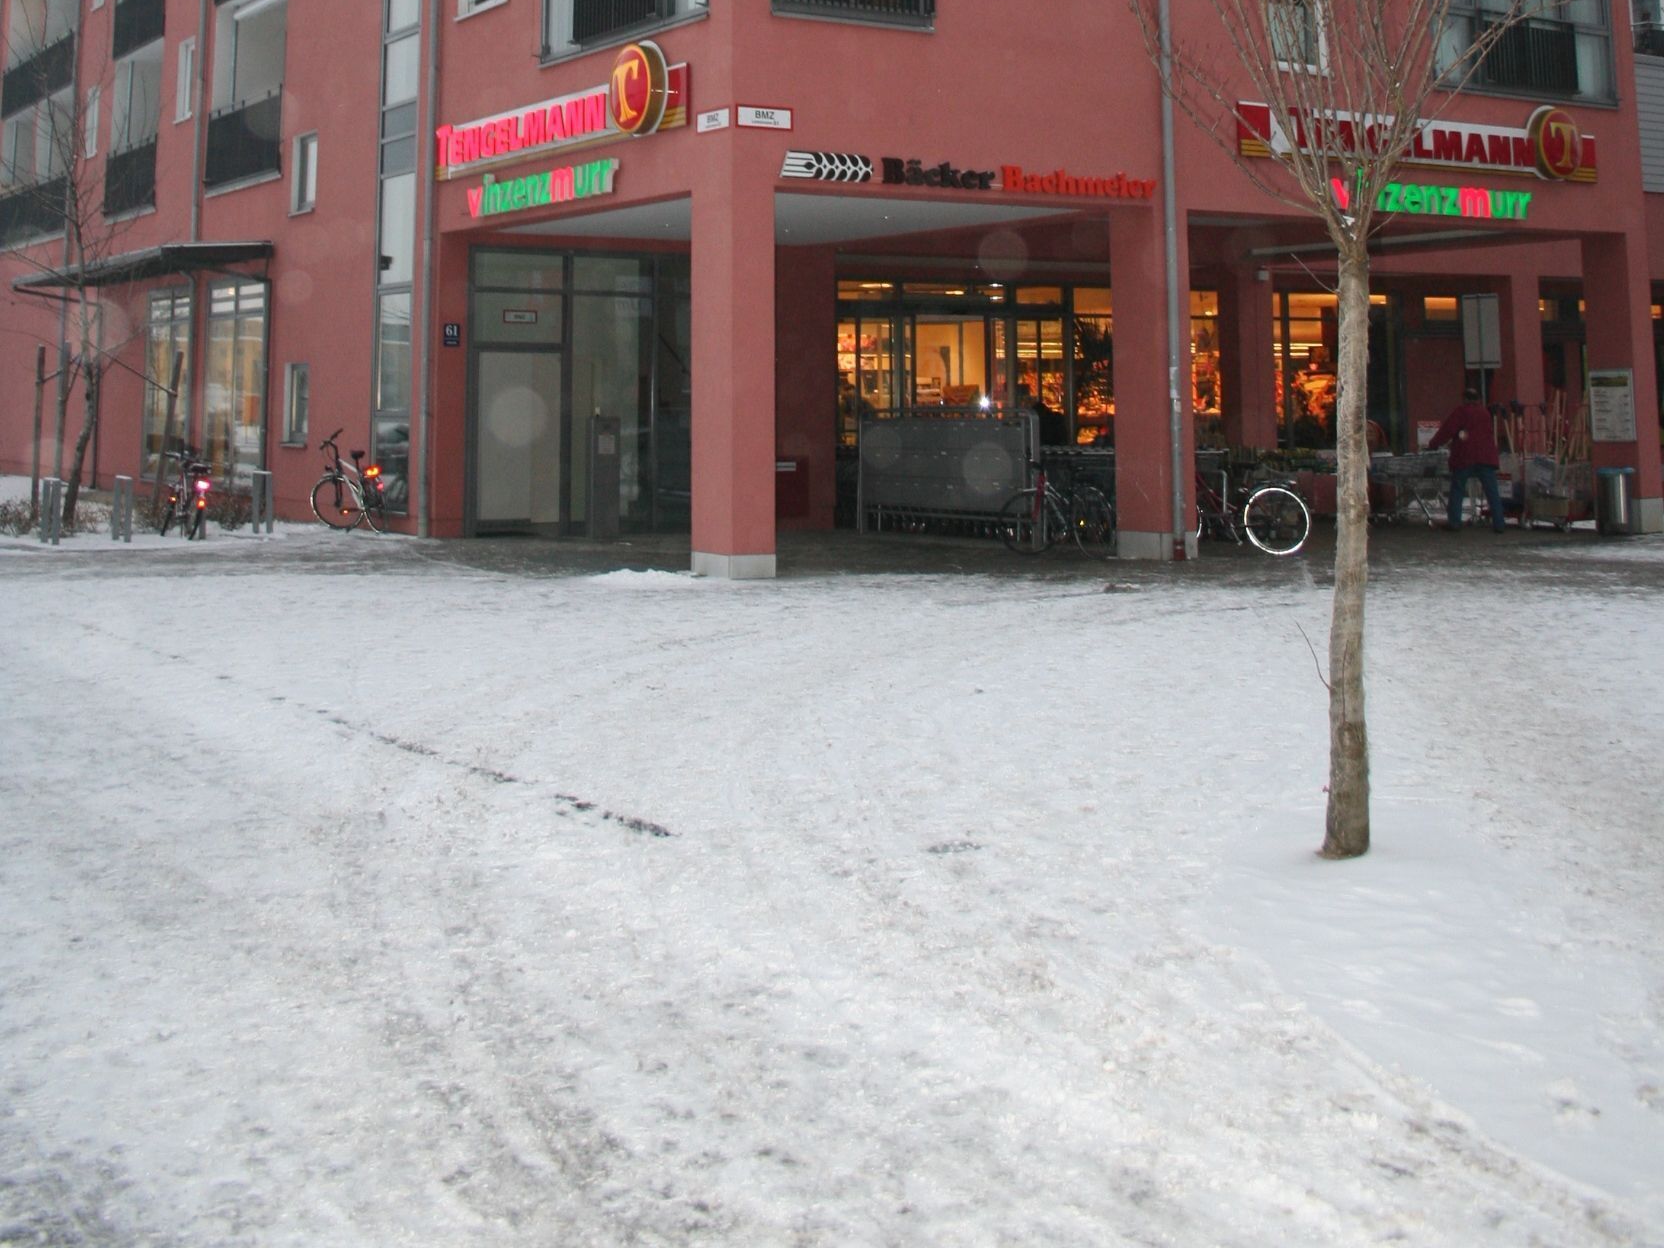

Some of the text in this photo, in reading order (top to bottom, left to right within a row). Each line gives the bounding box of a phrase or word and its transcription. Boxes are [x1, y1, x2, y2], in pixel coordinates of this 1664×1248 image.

[436, 92, 608, 168] TENGELMANN
[755, 110, 774, 120] BMZ
[466, 158, 614, 219] vinzenzmurr
[881, 157, 1157, 198] Bäcker Bachmeier
[445, 325, 458, 337] 61
